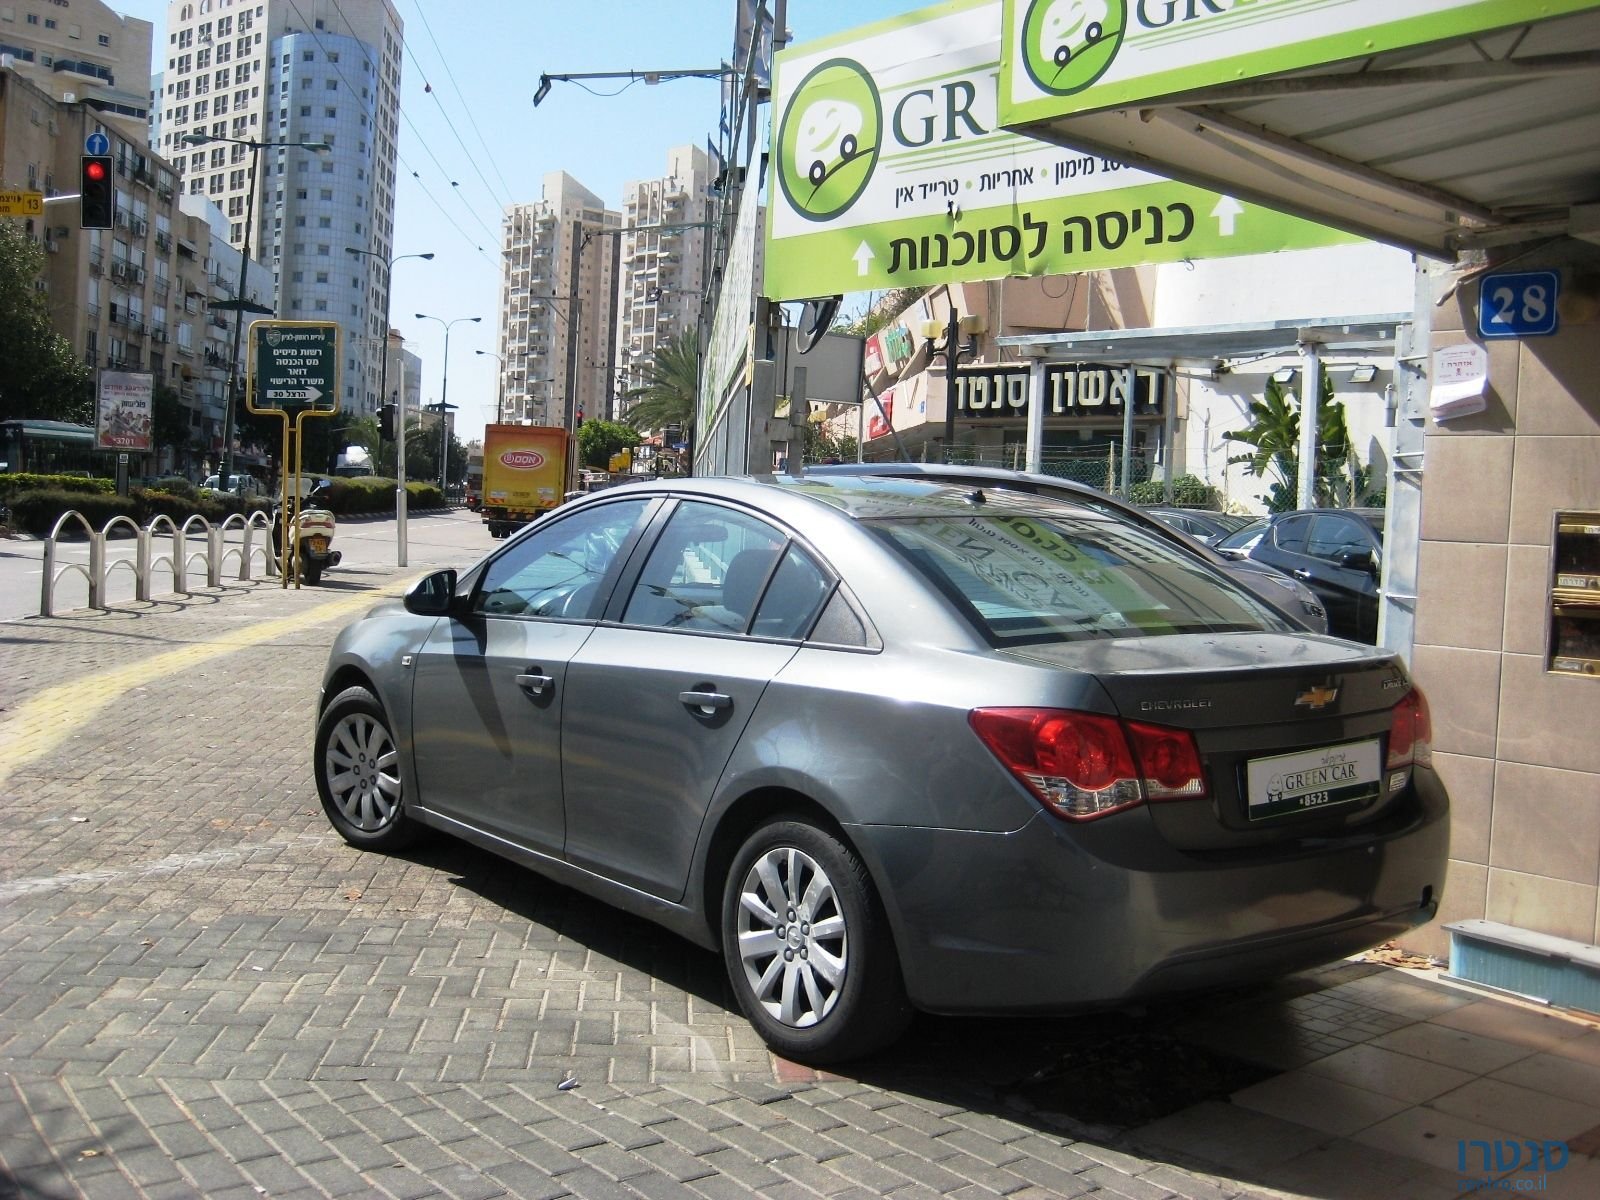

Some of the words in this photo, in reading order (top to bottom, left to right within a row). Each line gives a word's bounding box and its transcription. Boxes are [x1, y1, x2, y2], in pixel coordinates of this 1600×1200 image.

[979, 166, 1034, 192] אחריות
[1056, 156, 1095, 186] מימון
[895, 185, 915, 209] אין
[918, 179, 959, 200] טרייד
[27, 199, 39, 210] 13
[1062, 202, 1195, 255] כניסה
[887, 212, 1048, 275] לסוכנות
[1490, 284, 1546, 325] 28
[273, 348, 297, 356] מיסים
[300, 348, 322, 356] רשות
[1050, 369, 1159, 413] ראשון
[1140, 699, 1213, 711] CHEVROLET
[1285, 768, 1327, 790] GREEN
[1332, 763, 1357, 781] CAR
